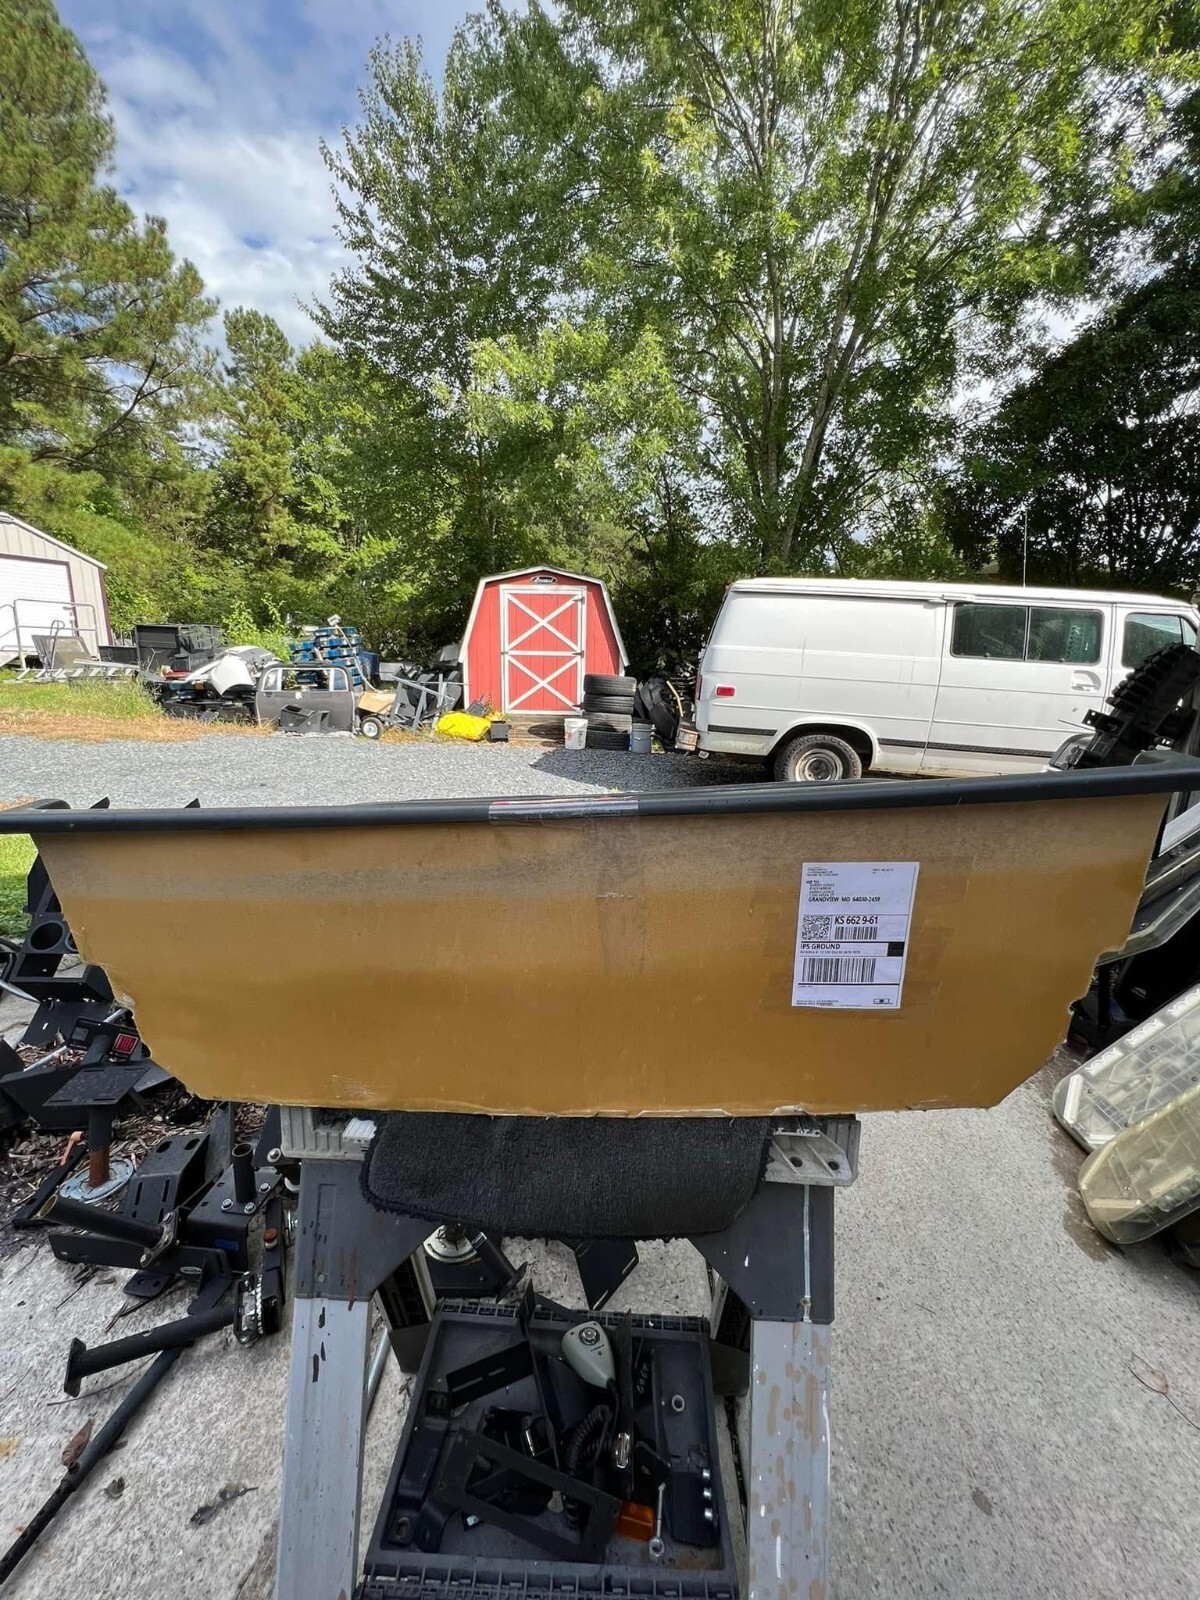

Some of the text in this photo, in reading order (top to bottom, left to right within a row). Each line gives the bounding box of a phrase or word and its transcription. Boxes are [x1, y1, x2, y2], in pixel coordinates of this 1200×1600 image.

[834, 915, 879, 924] KS 662 9-61
